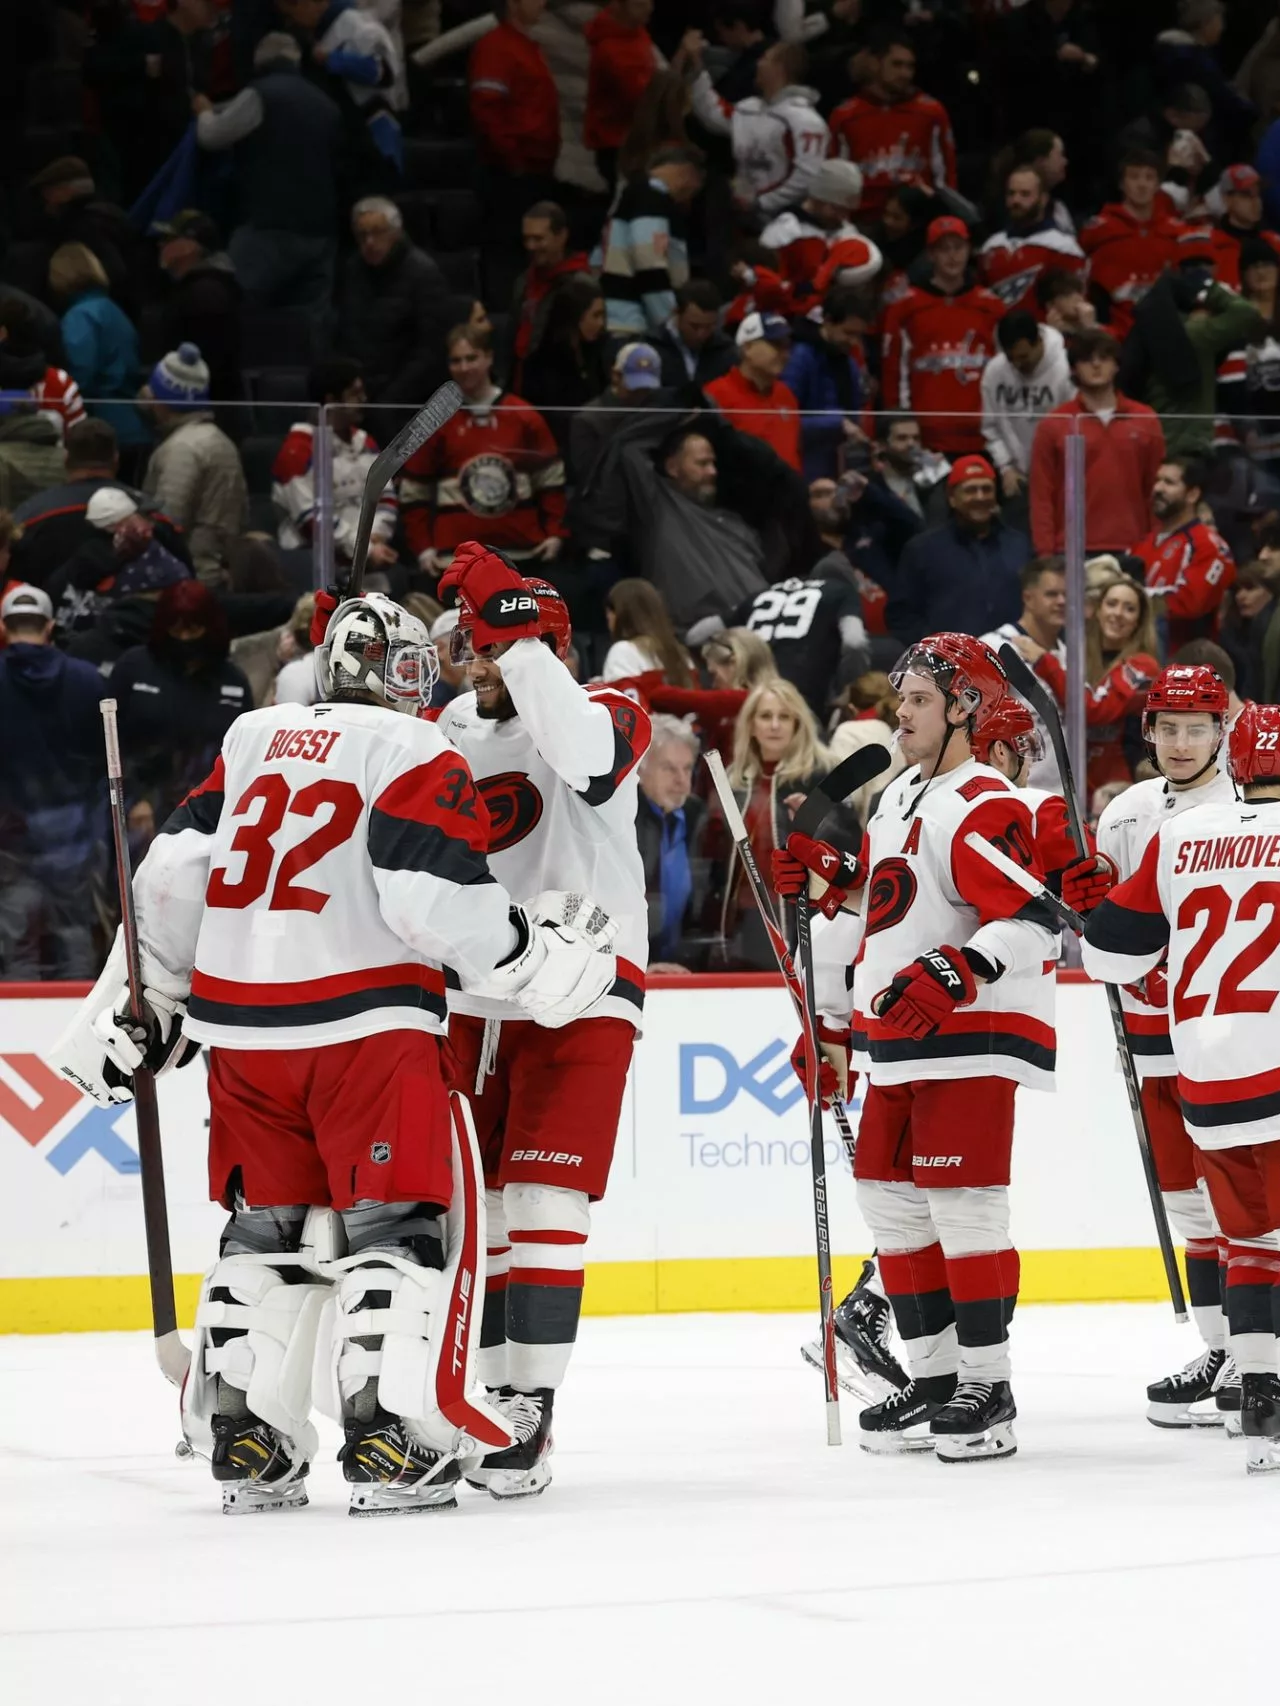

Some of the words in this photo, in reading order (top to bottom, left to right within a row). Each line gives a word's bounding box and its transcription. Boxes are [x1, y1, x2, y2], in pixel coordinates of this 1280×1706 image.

[997, 383, 1053, 407] NASA
[1205, 559, 1225, 586] 8
[746, 587, 822, 642] 29
[987, 652, 1006, 677] Lenovo
[264, 728, 341, 764] BUSSI
[1255, 731, 1279, 751] 22
[205, 773, 365, 915] 32
[901, 817, 922, 856] A
[60, 1066, 102, 1102] TRUE
[510, 1150, 584, 1168] BAUER
[680, 1133, 858, 1174] Technoo
[815, 1188, 829, 1254] BAUER
[452, 1268, 472, 1377] TRUE
[899, 1403, 928, 1423] BAUER
[370, 1452, 396, 1471] CCM
